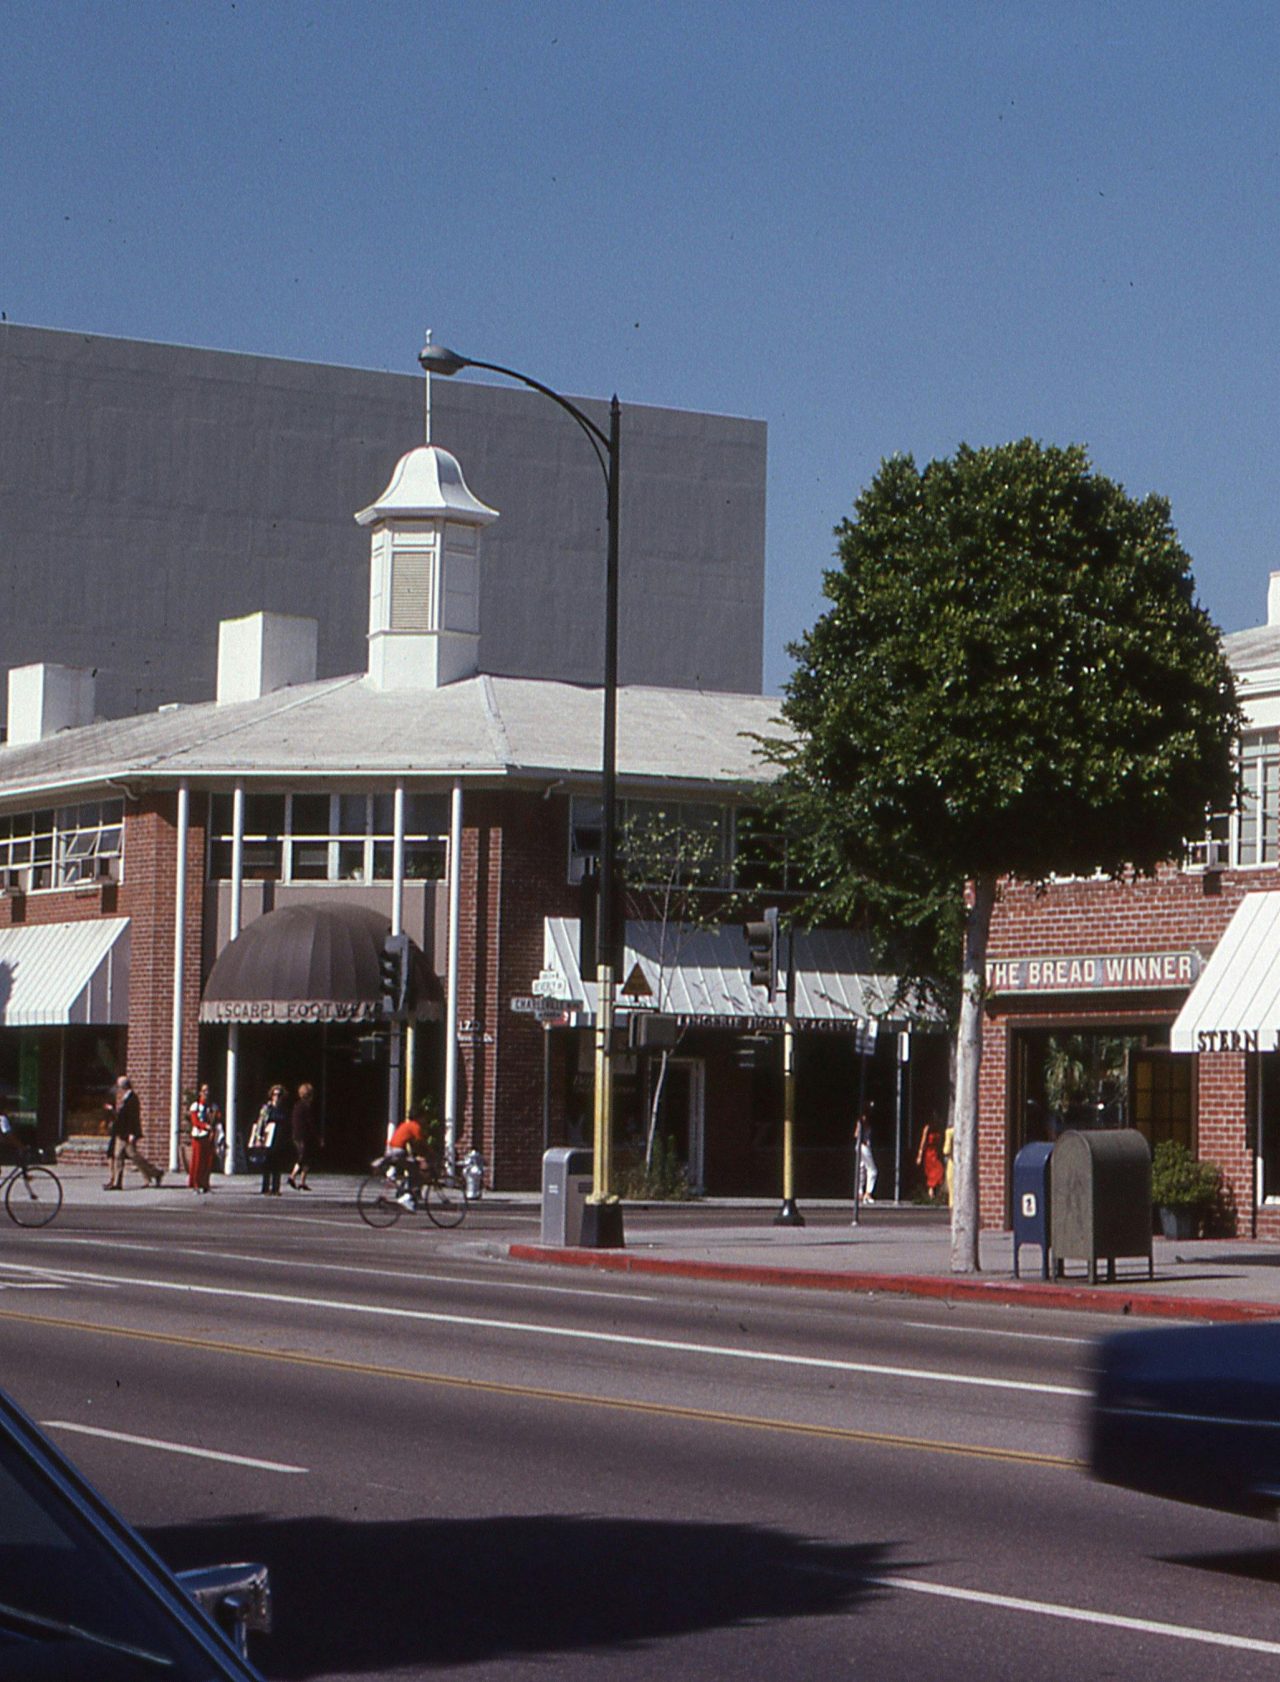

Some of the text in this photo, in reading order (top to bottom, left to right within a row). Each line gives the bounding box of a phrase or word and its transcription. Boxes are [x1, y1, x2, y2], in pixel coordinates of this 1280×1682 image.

[985, 955, 1192, 986] THE BREAD WINNER
[677, 1014, 740, 1028] LINGERIE
[747, 1016, 808, 1030] HOSIY
[1198, 1029, 1259, 1052] STERN
